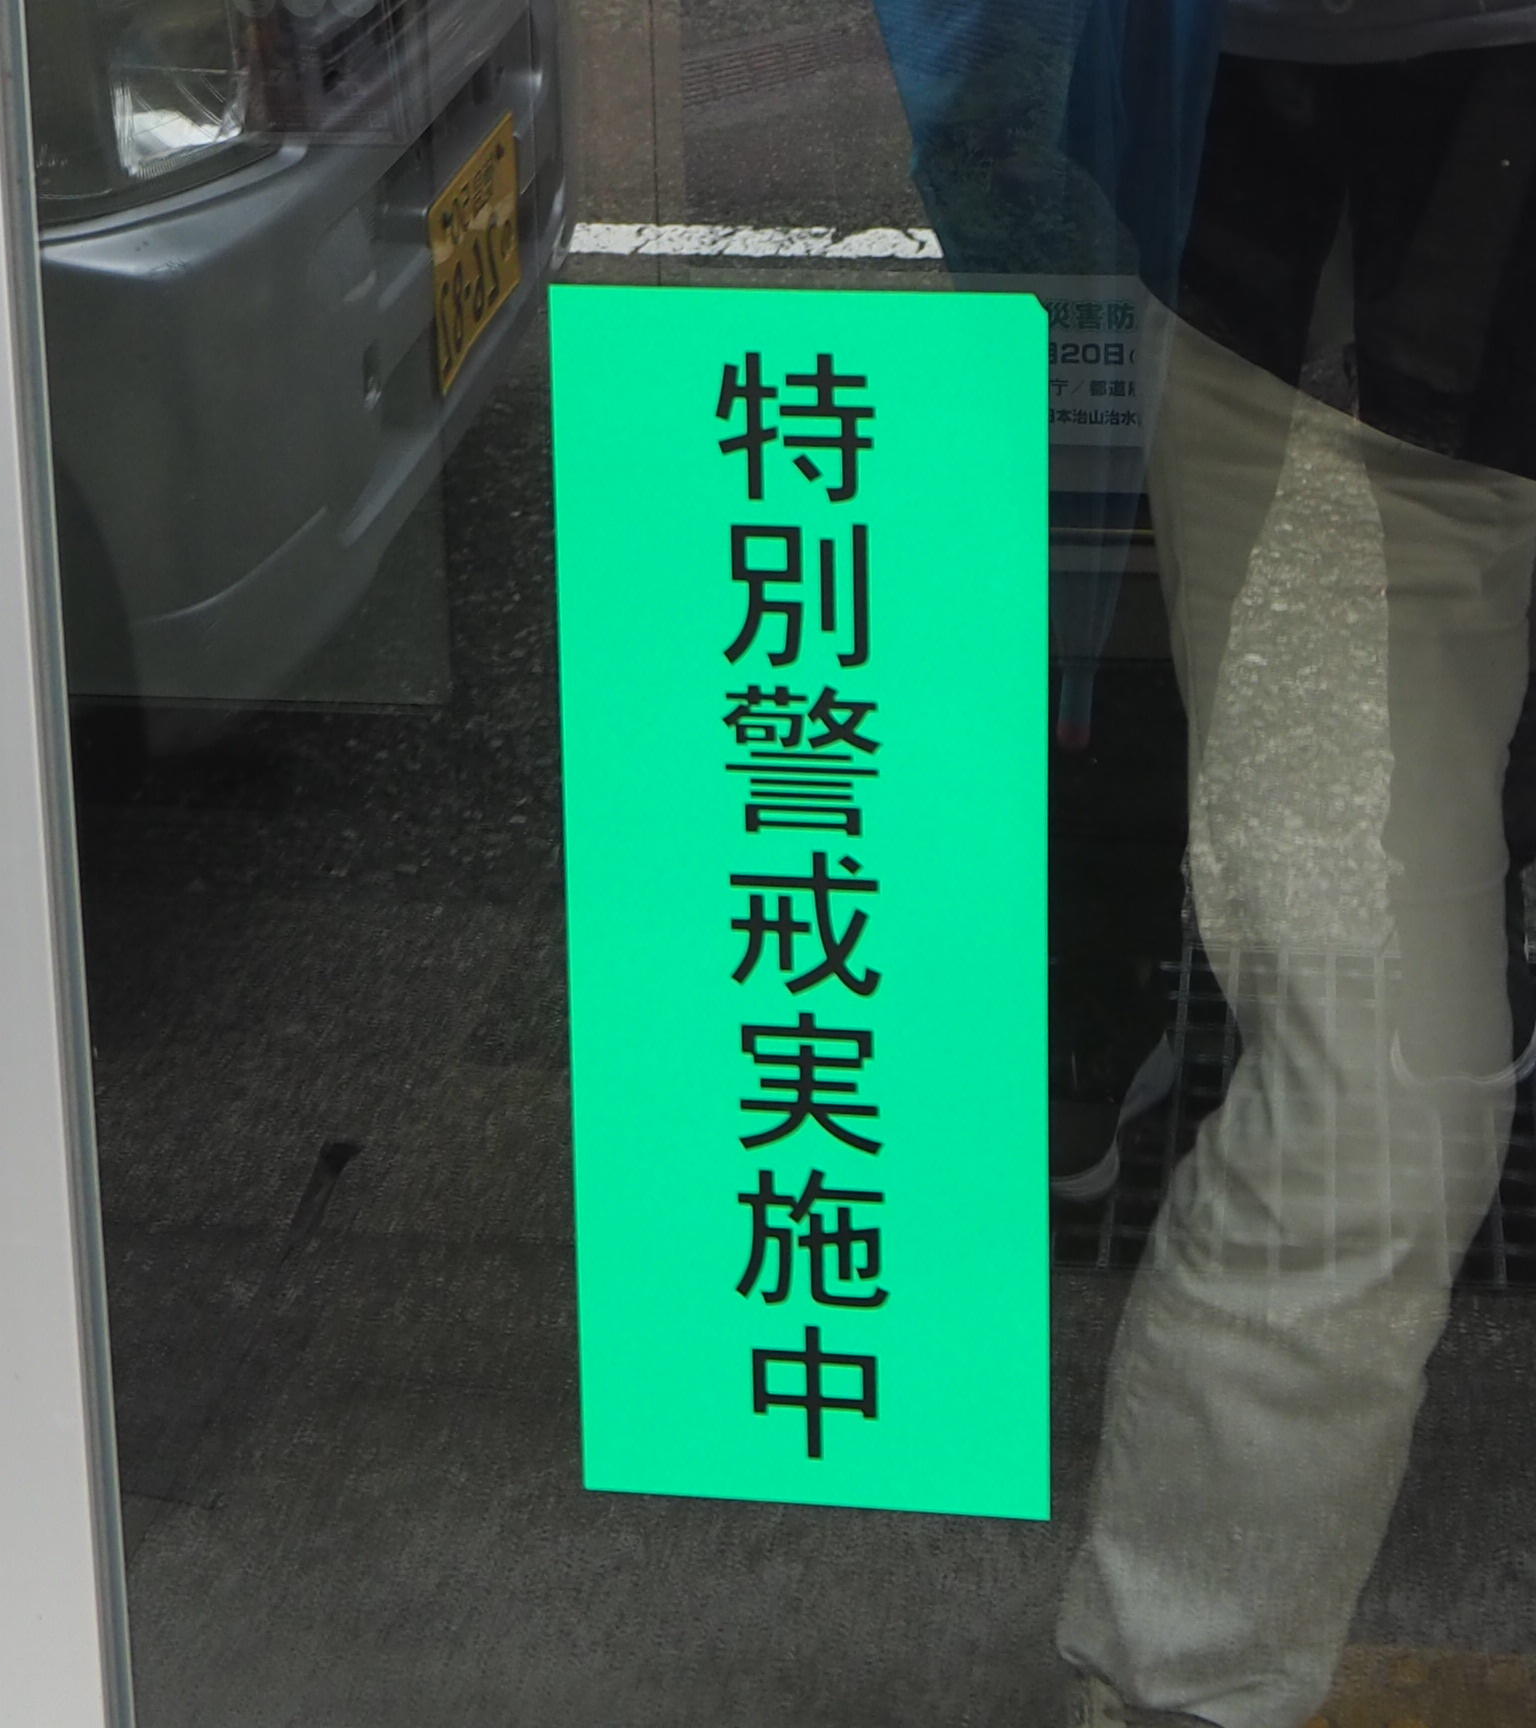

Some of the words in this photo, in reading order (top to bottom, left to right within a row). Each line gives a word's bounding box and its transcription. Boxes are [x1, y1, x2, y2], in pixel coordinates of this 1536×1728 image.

[715, 352, 889, 1460] 特別警戒実施中
